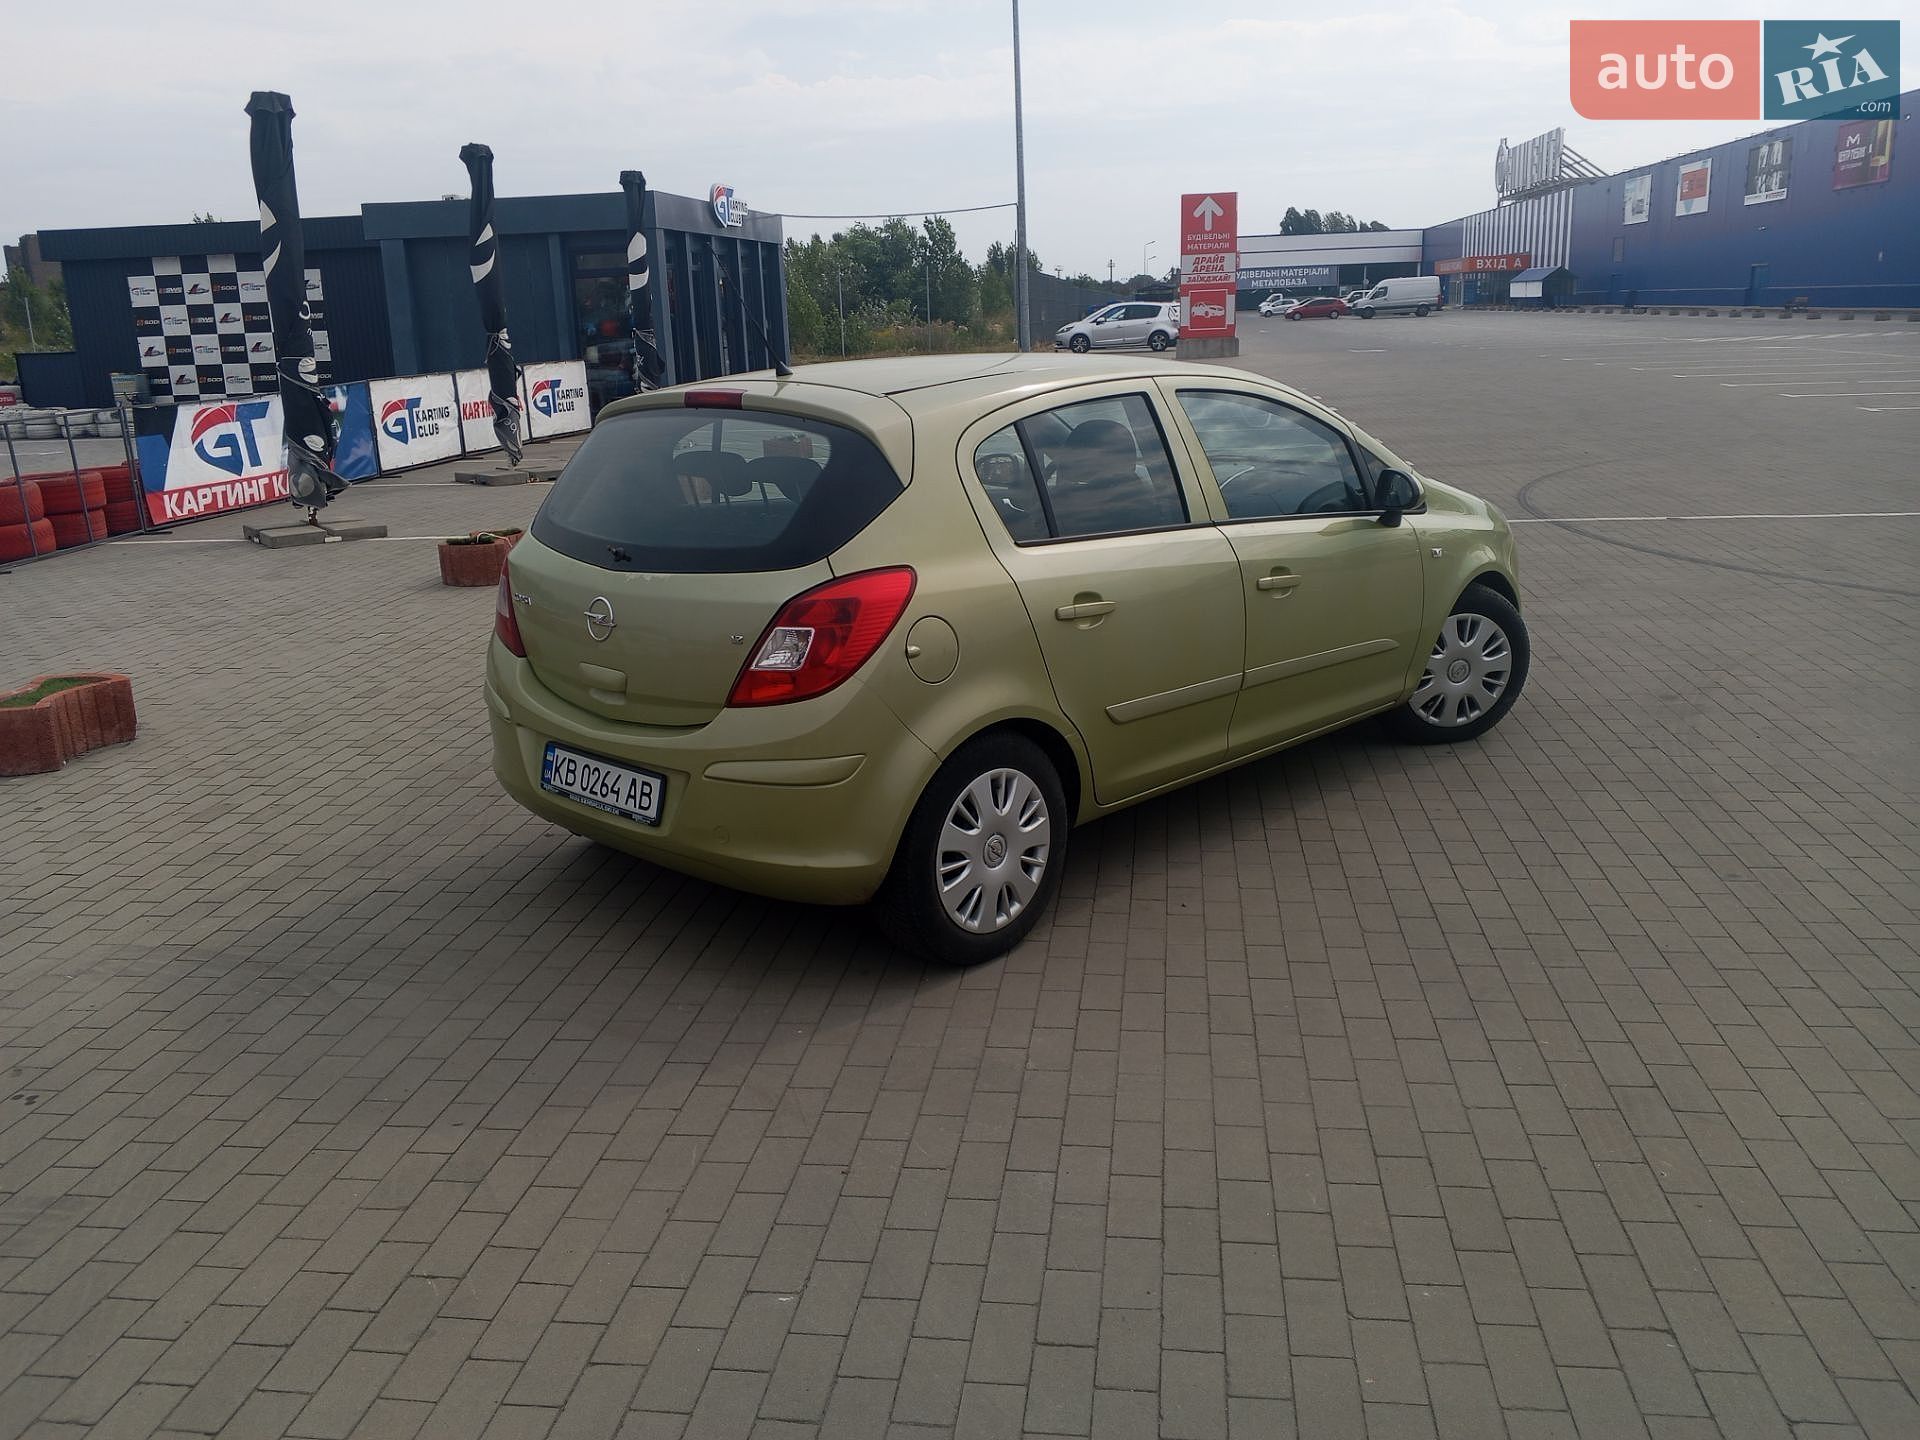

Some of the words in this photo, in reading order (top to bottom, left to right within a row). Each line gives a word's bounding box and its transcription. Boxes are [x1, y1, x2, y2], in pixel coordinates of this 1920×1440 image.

[1187, 232, 1230, 241] БУДІВЕЛЬНІ
[1187, 242, 1230, 250] МАТЕРІАЛИ
[1192, 254, 1225, 265] ДРАЙВ
[1476, 258, 1507, 270] ВХІД
[1192, 264, 1225, 273] АРЕНА
[1236, 269, 1280, 279] УДІВЕЛЬНІ
[1281, 267, 1329, 277] МАТЕРІАЛИ
[1251, 278, 1307, 288] МЕТАЛОБАЗА
[532, 379, 562, 418] GT
[556, 387, 583, 401] KARTING
[462, 400, 495, 421] KARTIN
[557, 401, 575, 413] CLUB
[381, 397, 422, 445] GT
[415, 406, 450, 423] KARTING
[417, 423, 439, 438] CLUB
[191, 401, 270, 477] GT
[163, 477, 271, 519] КАРТИНГ
[553, 754, 578, 787] KB
[580, 764, 622, 803] 0264
[625, 777, 653, 812] AB
